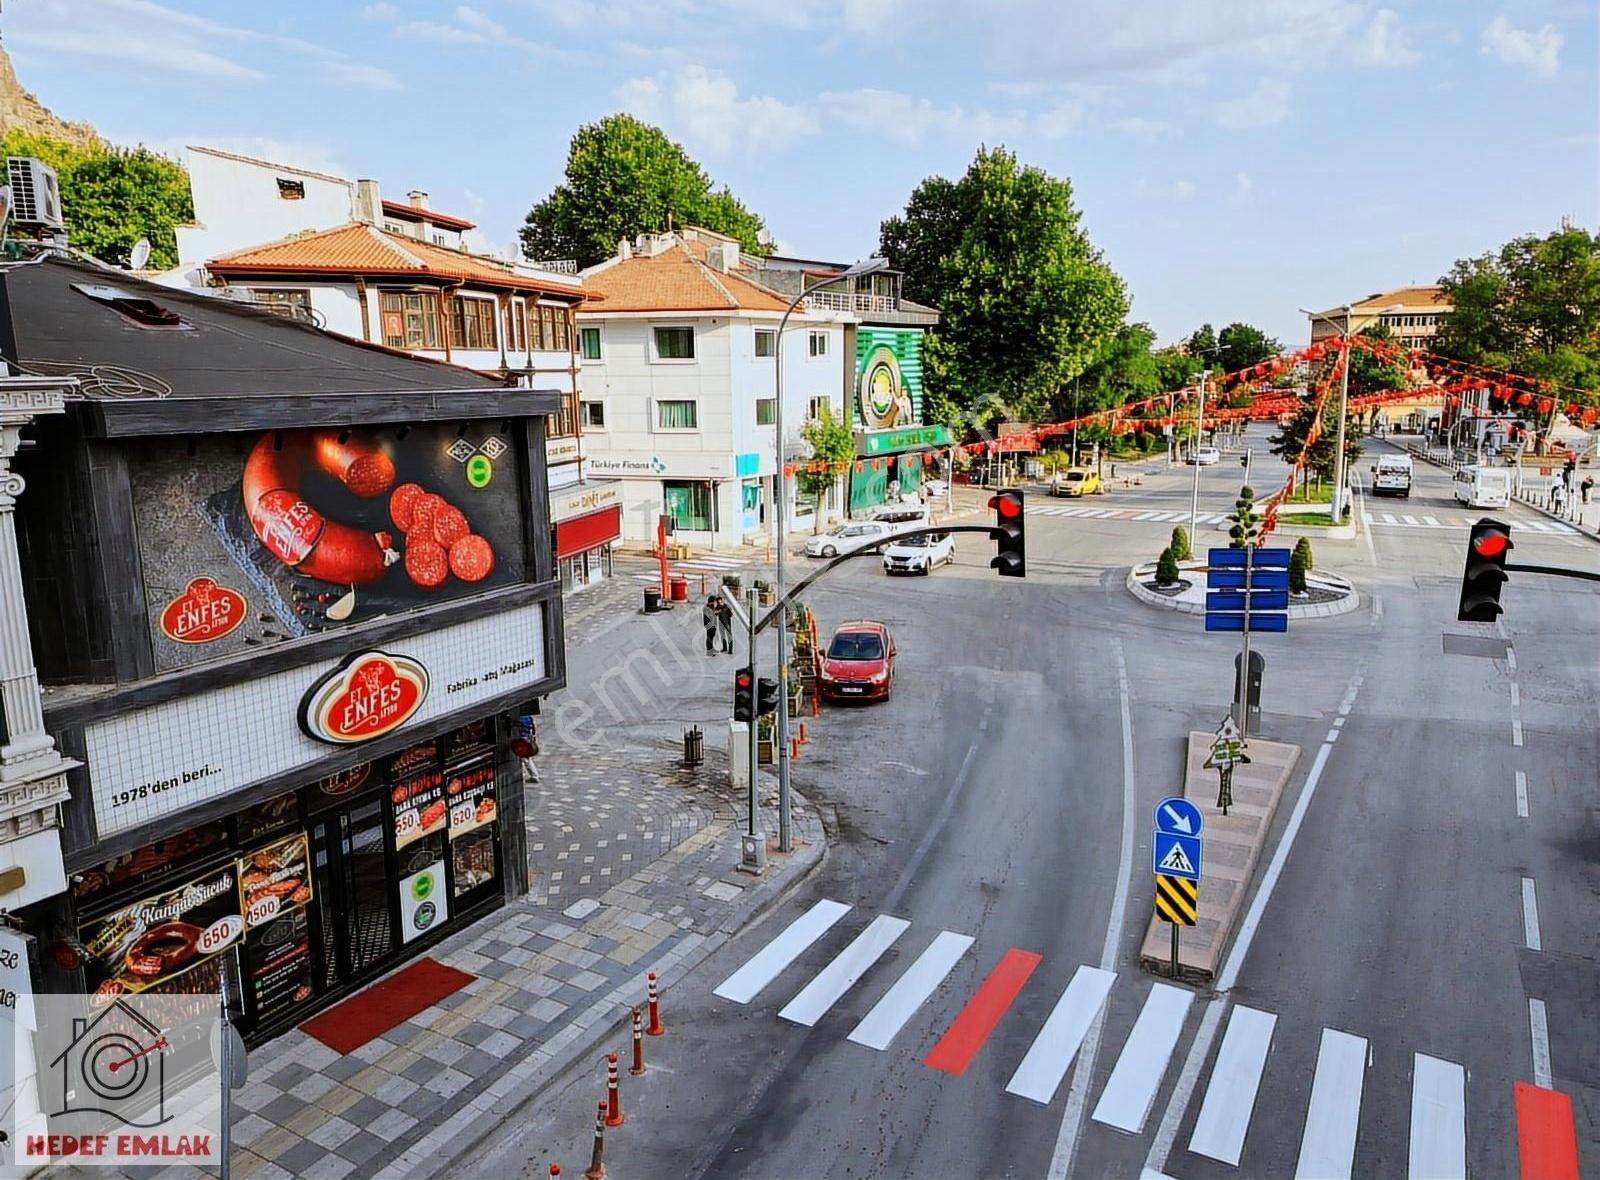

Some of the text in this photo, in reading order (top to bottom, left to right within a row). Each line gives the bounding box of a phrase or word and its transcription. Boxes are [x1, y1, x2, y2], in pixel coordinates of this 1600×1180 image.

[177, 596, 231, 633] ENFES
[344, 680, 401, 729] ENFES
[112, 764, 222, 808] 1978'den beri...
[202, 922, 231, 949] 650
